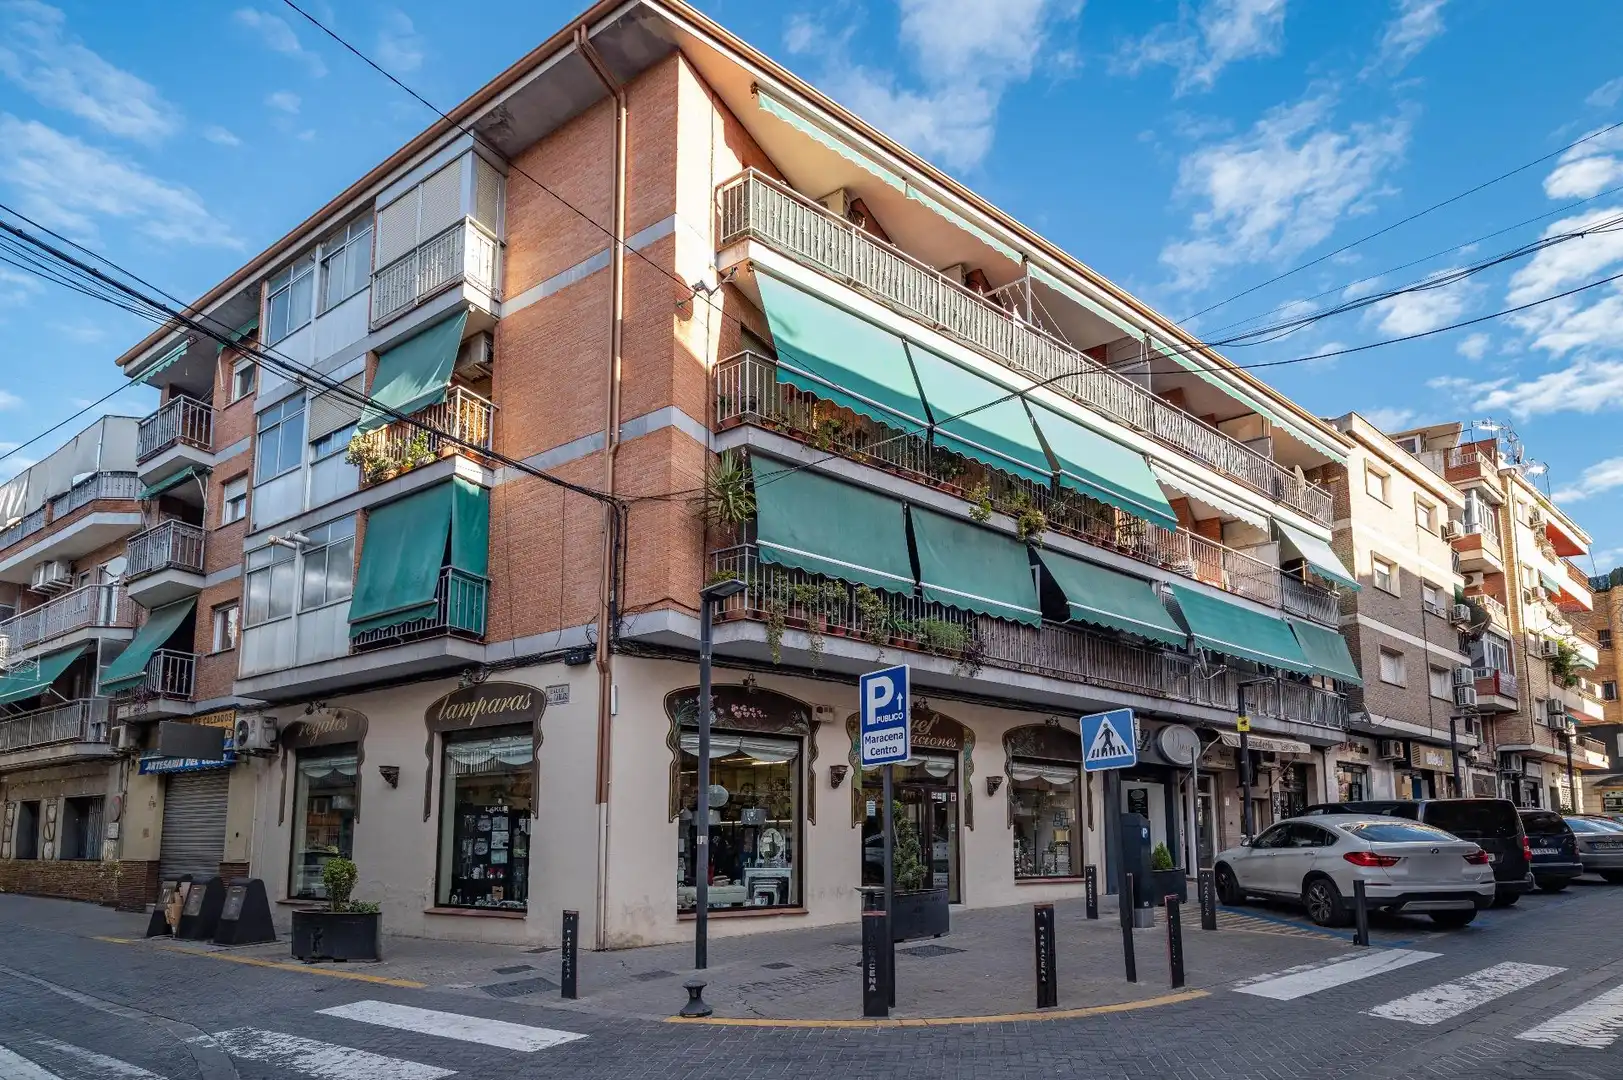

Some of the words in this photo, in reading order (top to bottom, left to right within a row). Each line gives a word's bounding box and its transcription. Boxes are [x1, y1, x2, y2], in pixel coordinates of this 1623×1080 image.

[866, 675, 895, 726] P
[203, 712, 233, 725] CALZADOS
[864, 732, 904, 745] Maracena
[870, 745, 898, 756] Centro
[184, 758, 199, 767] DEL
